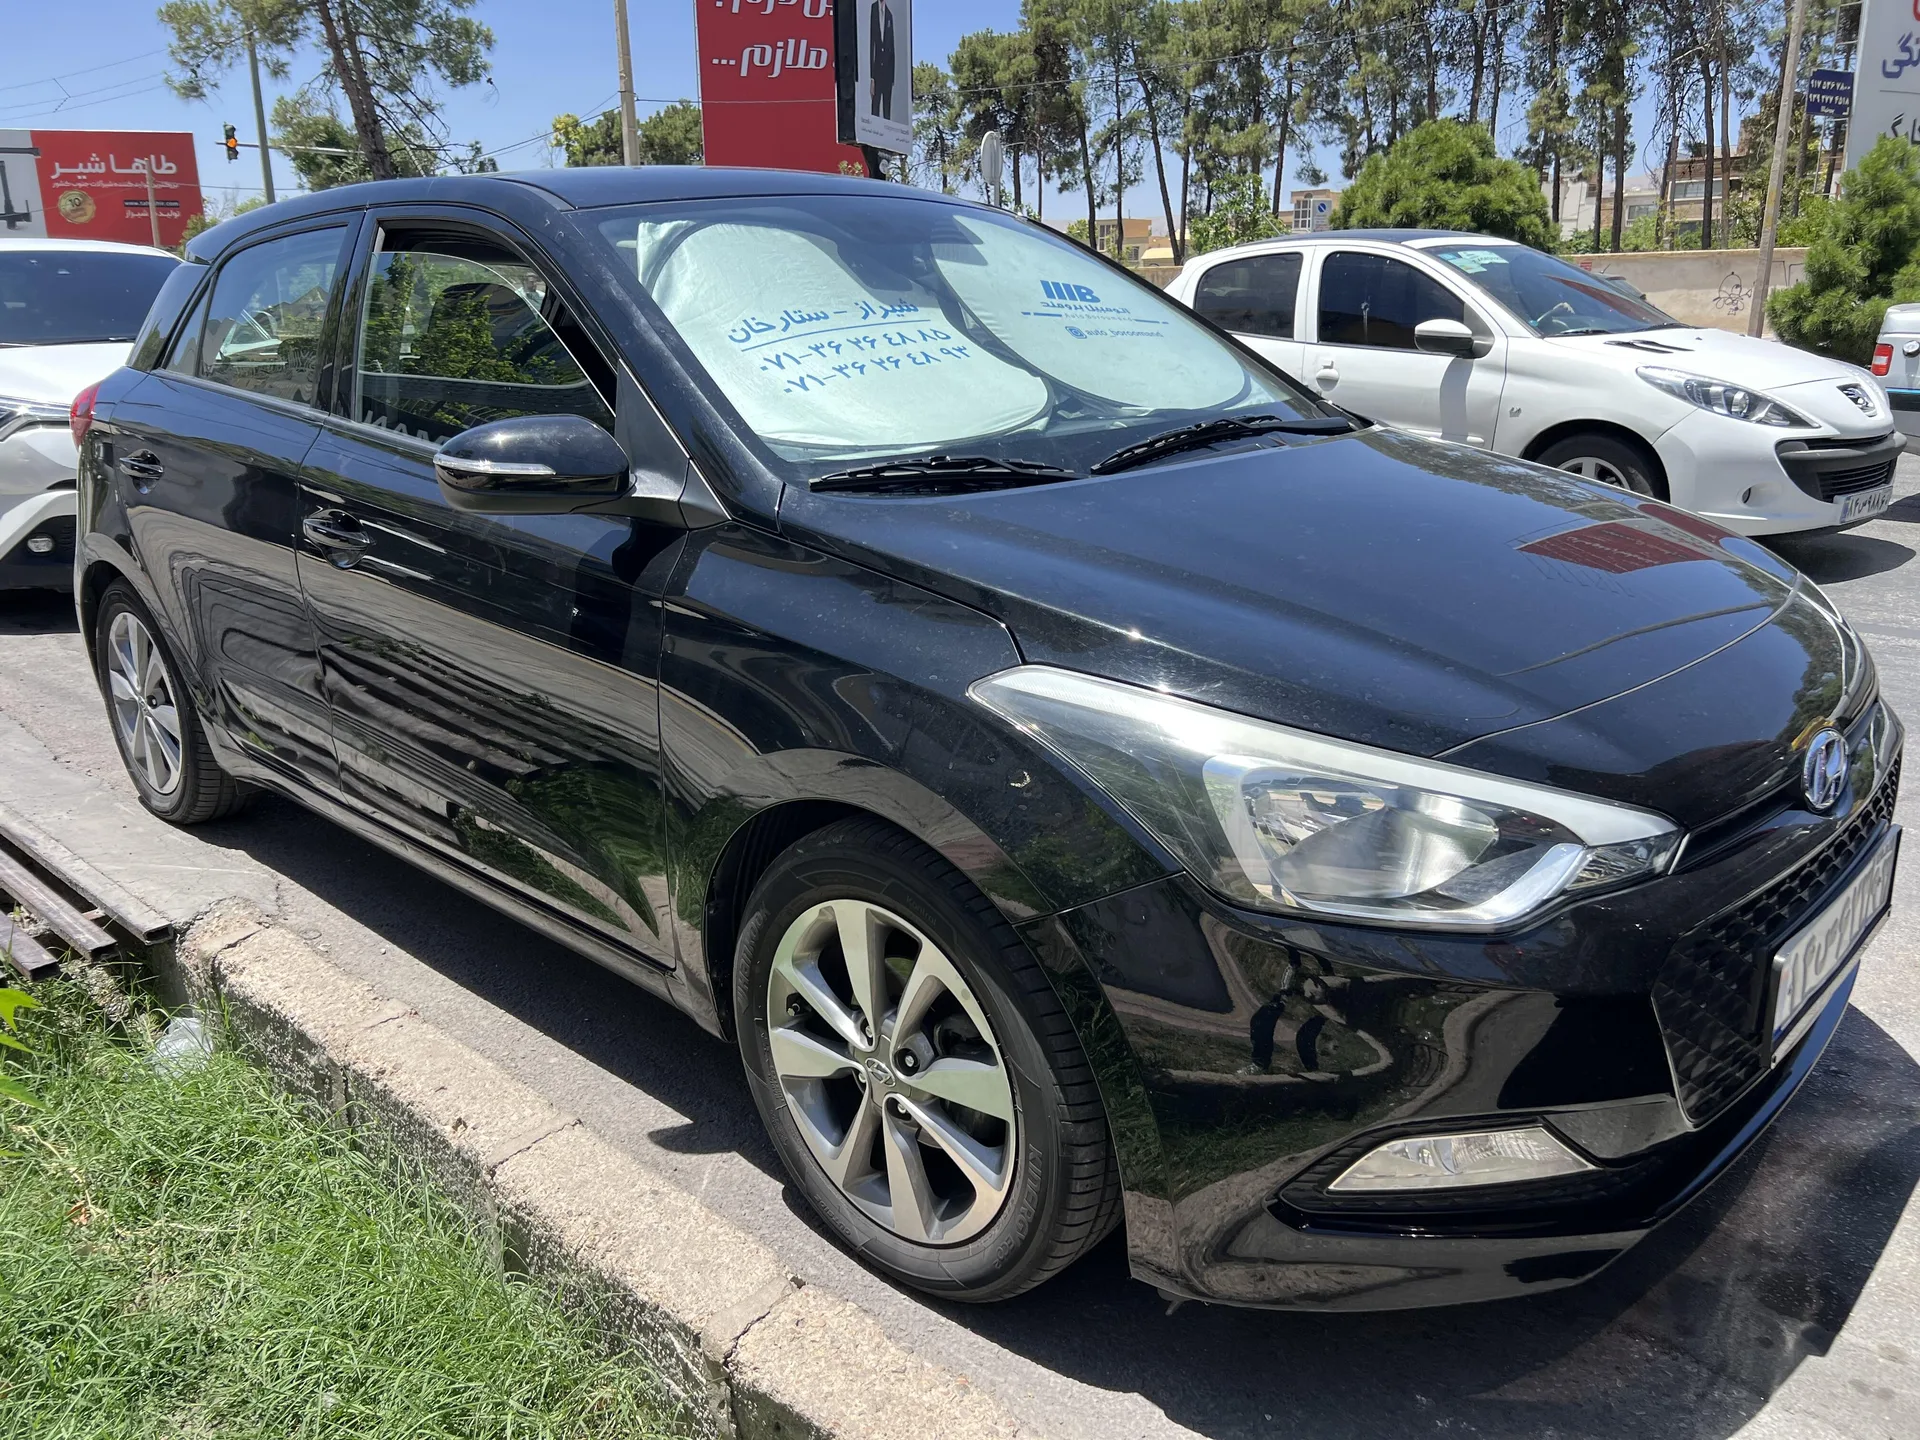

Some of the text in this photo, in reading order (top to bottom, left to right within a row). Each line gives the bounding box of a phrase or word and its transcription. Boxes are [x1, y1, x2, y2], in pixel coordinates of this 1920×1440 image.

[50, 152, 177, 179] طاها شیر
[854, 298, 919, 320] شیراز
